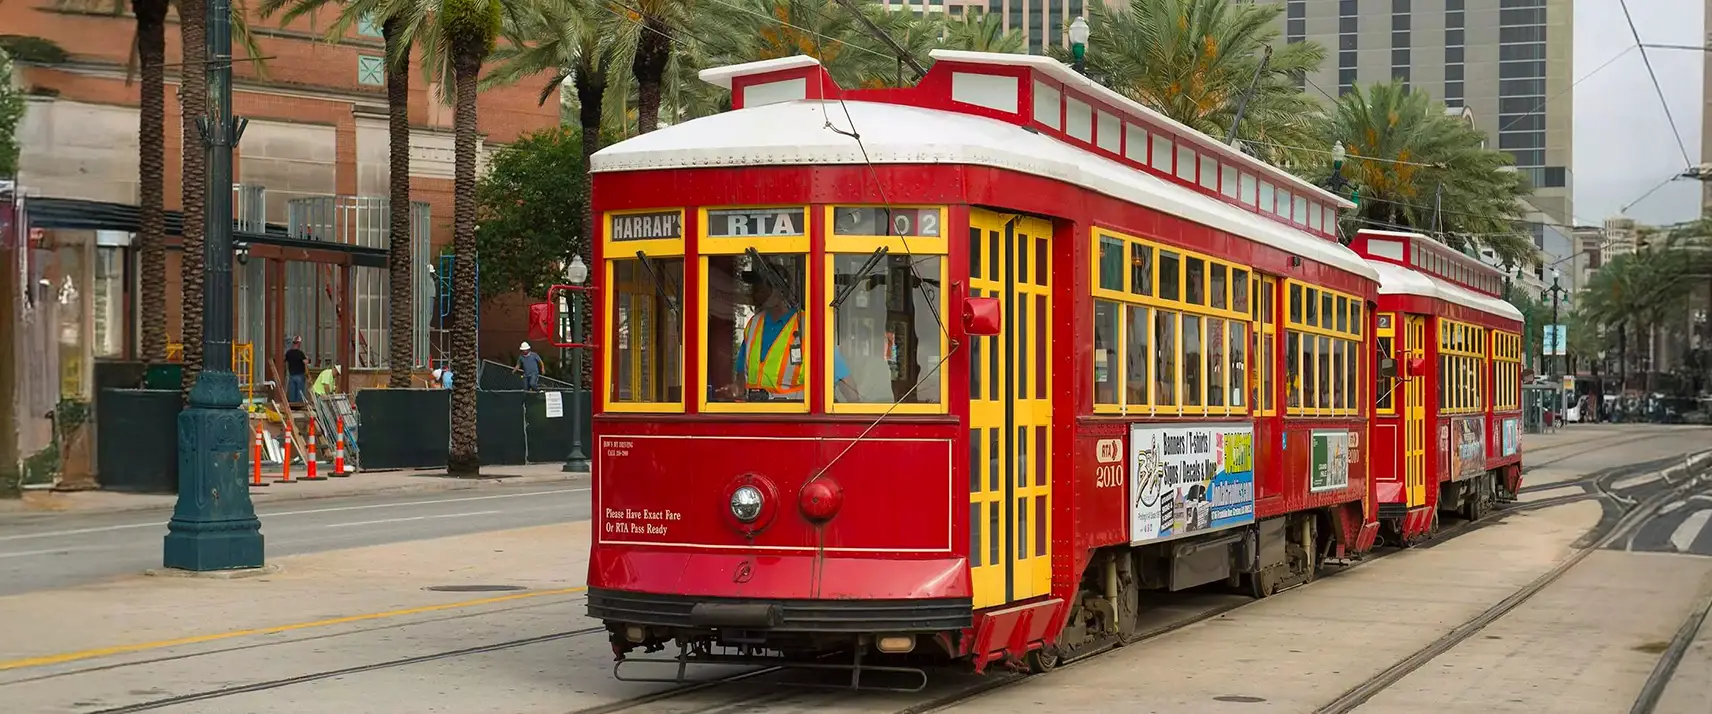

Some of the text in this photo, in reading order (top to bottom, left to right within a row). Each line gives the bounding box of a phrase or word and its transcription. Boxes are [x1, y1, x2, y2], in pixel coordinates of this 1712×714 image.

[727, 213, 797, 236] RTA
[1163, 432, 1185, 456] Banners
[1096, 465, 1123, 488] 2010
[606, 507, 681, 520] Please Have Exact Fare
[605, 522, 668, 536] Or RTA Pass Ready
